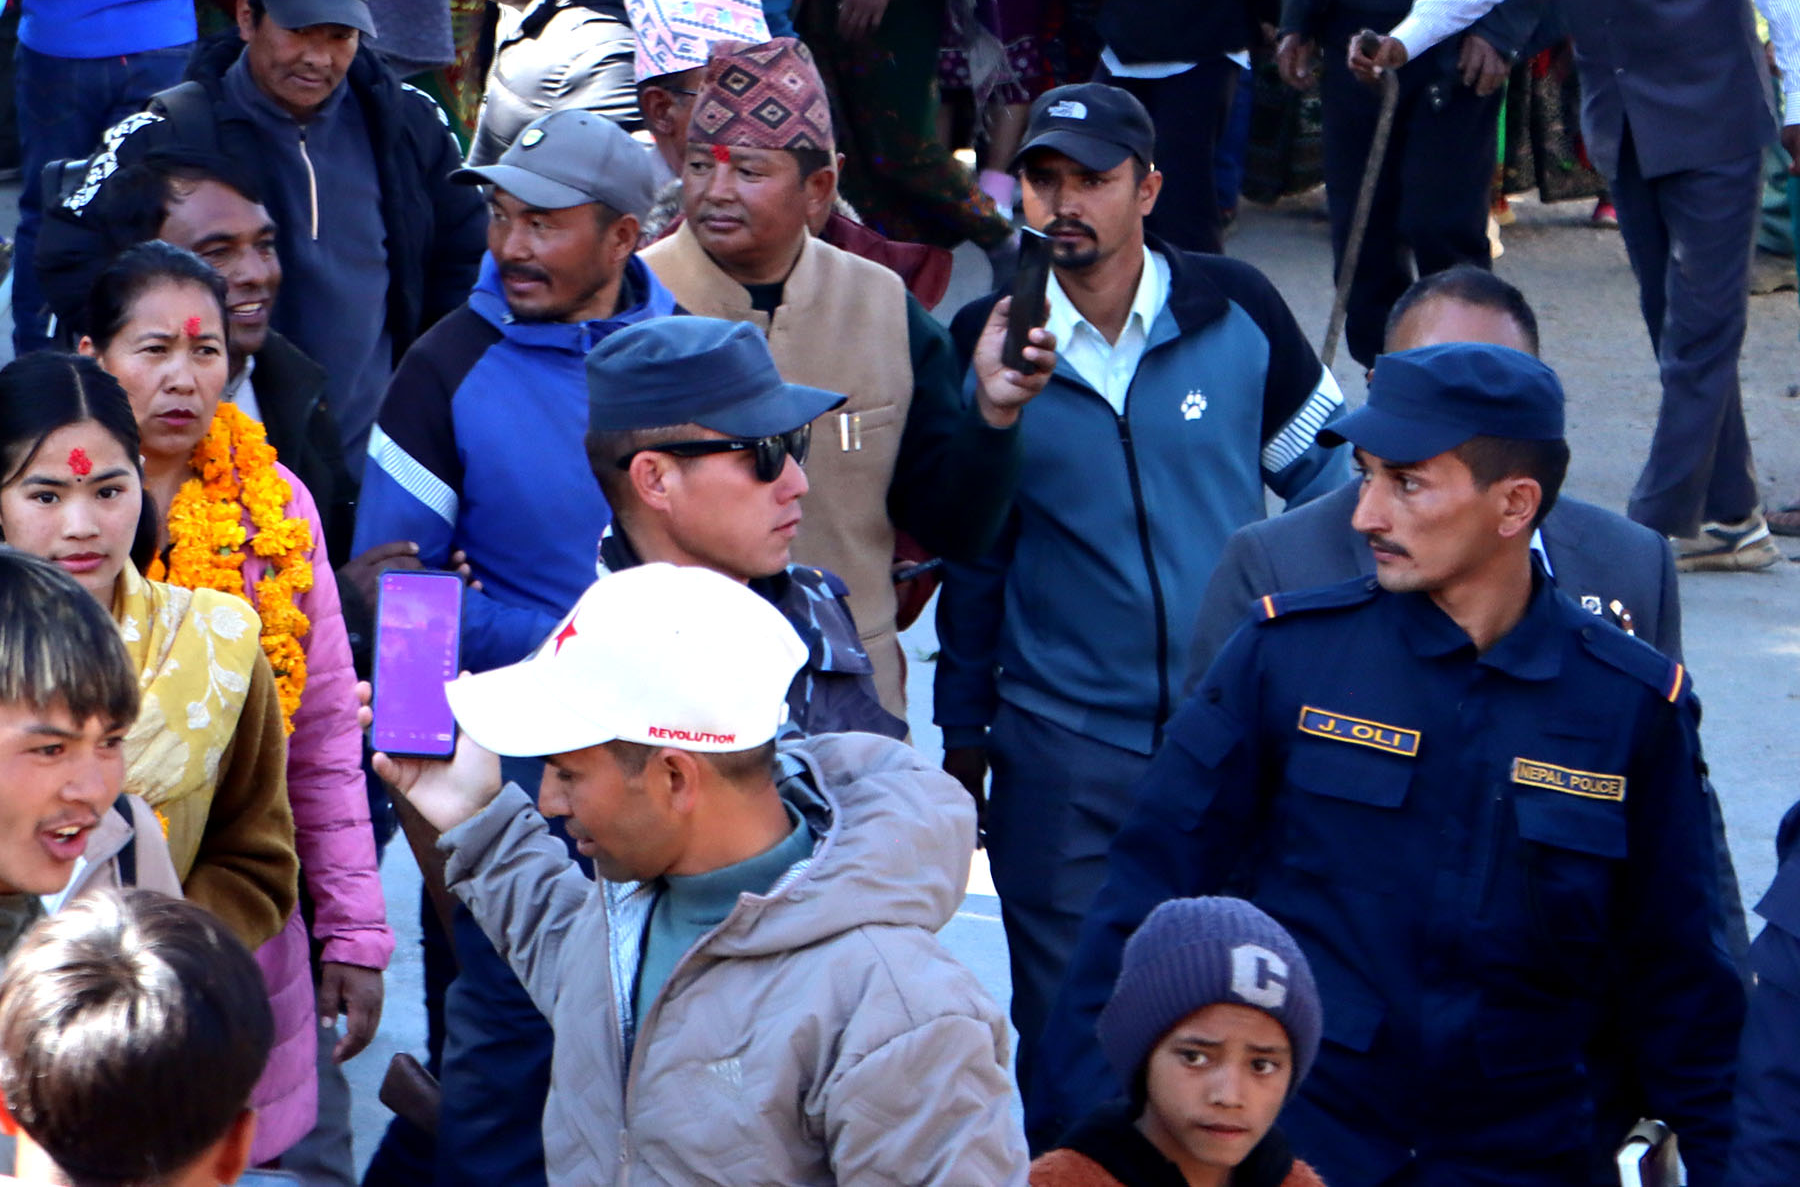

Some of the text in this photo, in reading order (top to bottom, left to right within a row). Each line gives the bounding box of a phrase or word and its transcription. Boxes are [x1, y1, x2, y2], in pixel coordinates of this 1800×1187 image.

[648, 726, 736, 744] REVOLUTION
[1317, 718, 1401, 747] J. OLI
[1519, 764, 1620, 795] NEPAL POLICE
[1230, 943, 1289, 1008] C
